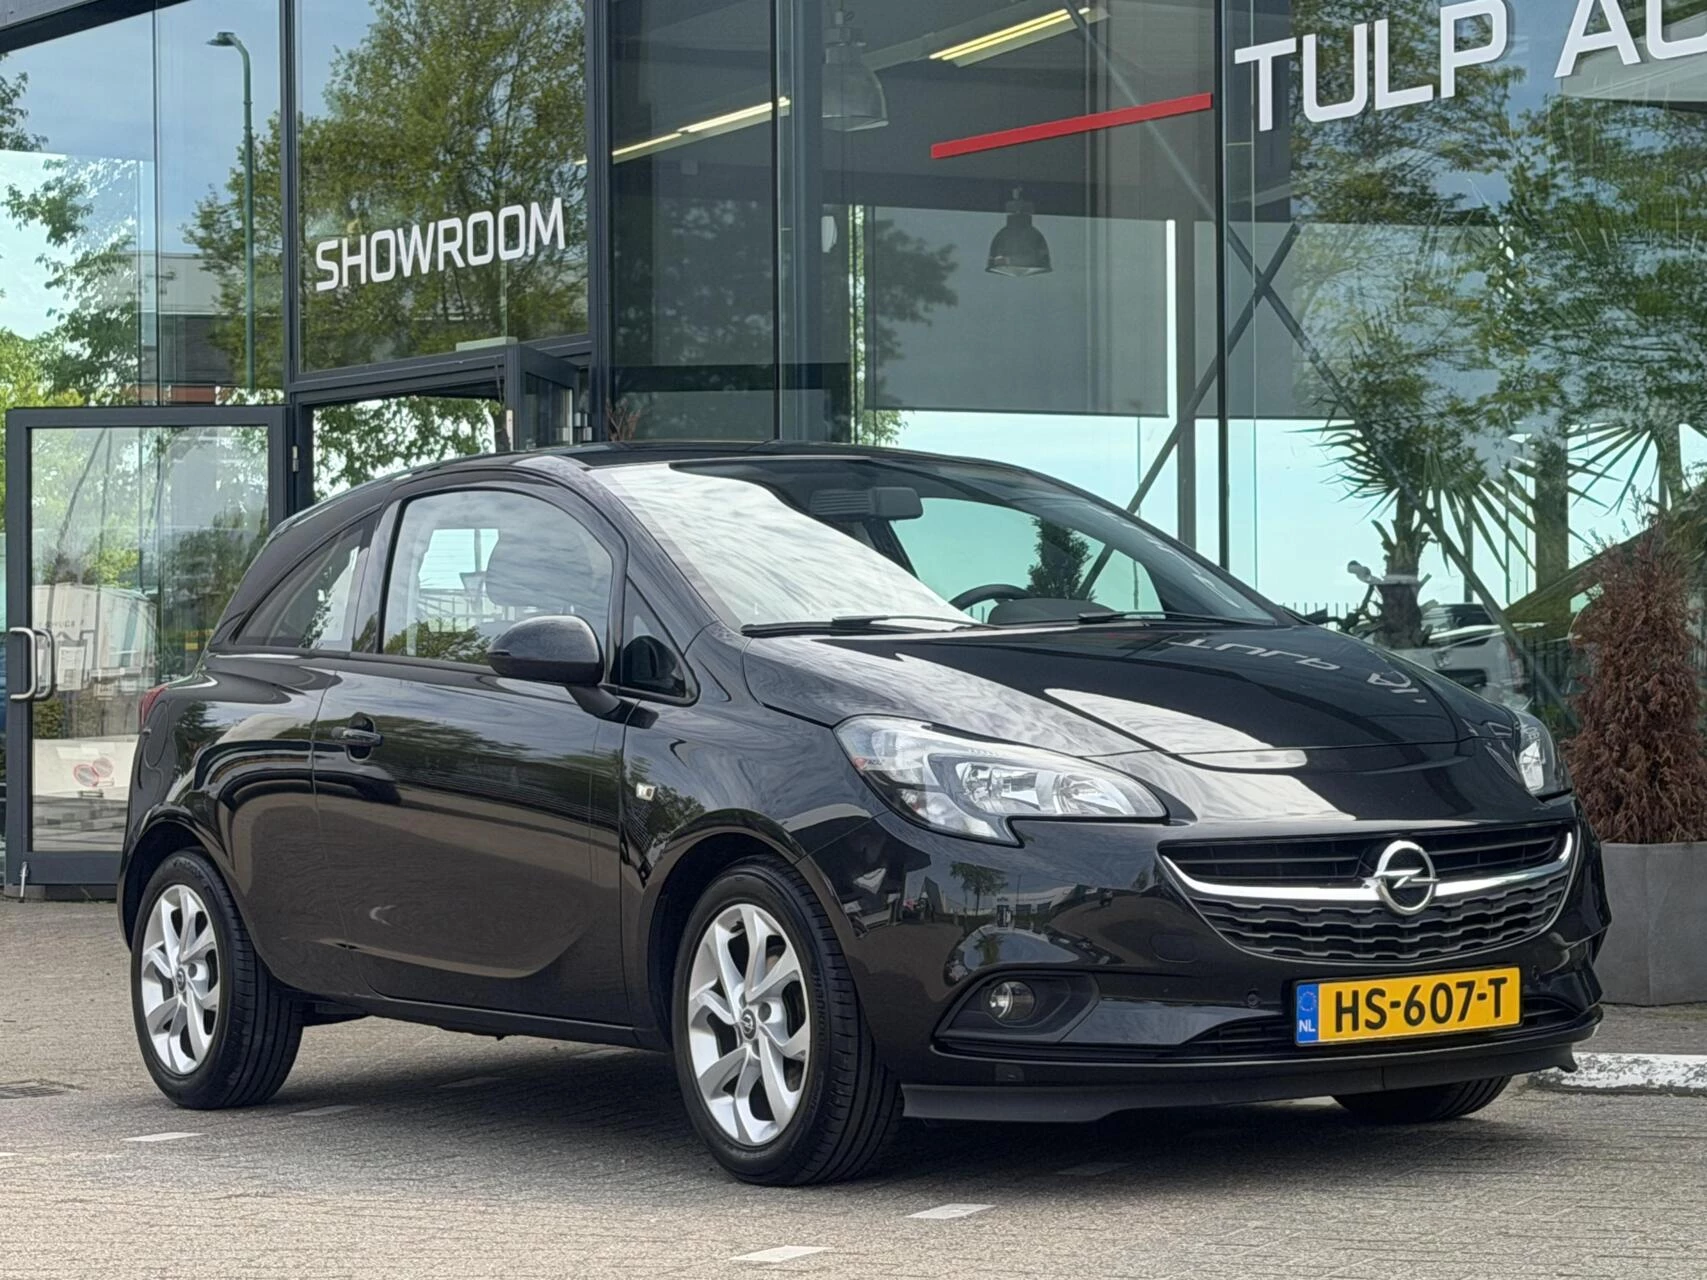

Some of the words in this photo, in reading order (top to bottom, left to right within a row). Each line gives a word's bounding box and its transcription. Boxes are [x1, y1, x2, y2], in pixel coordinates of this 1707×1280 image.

[1234, 0, 1508, 131] TULP
[315, 197, 566, 292] SHOWROOM
[1298, 1019, 1317, 1033] NL
[1335, 976, 1508, 1033] HS-607-T
